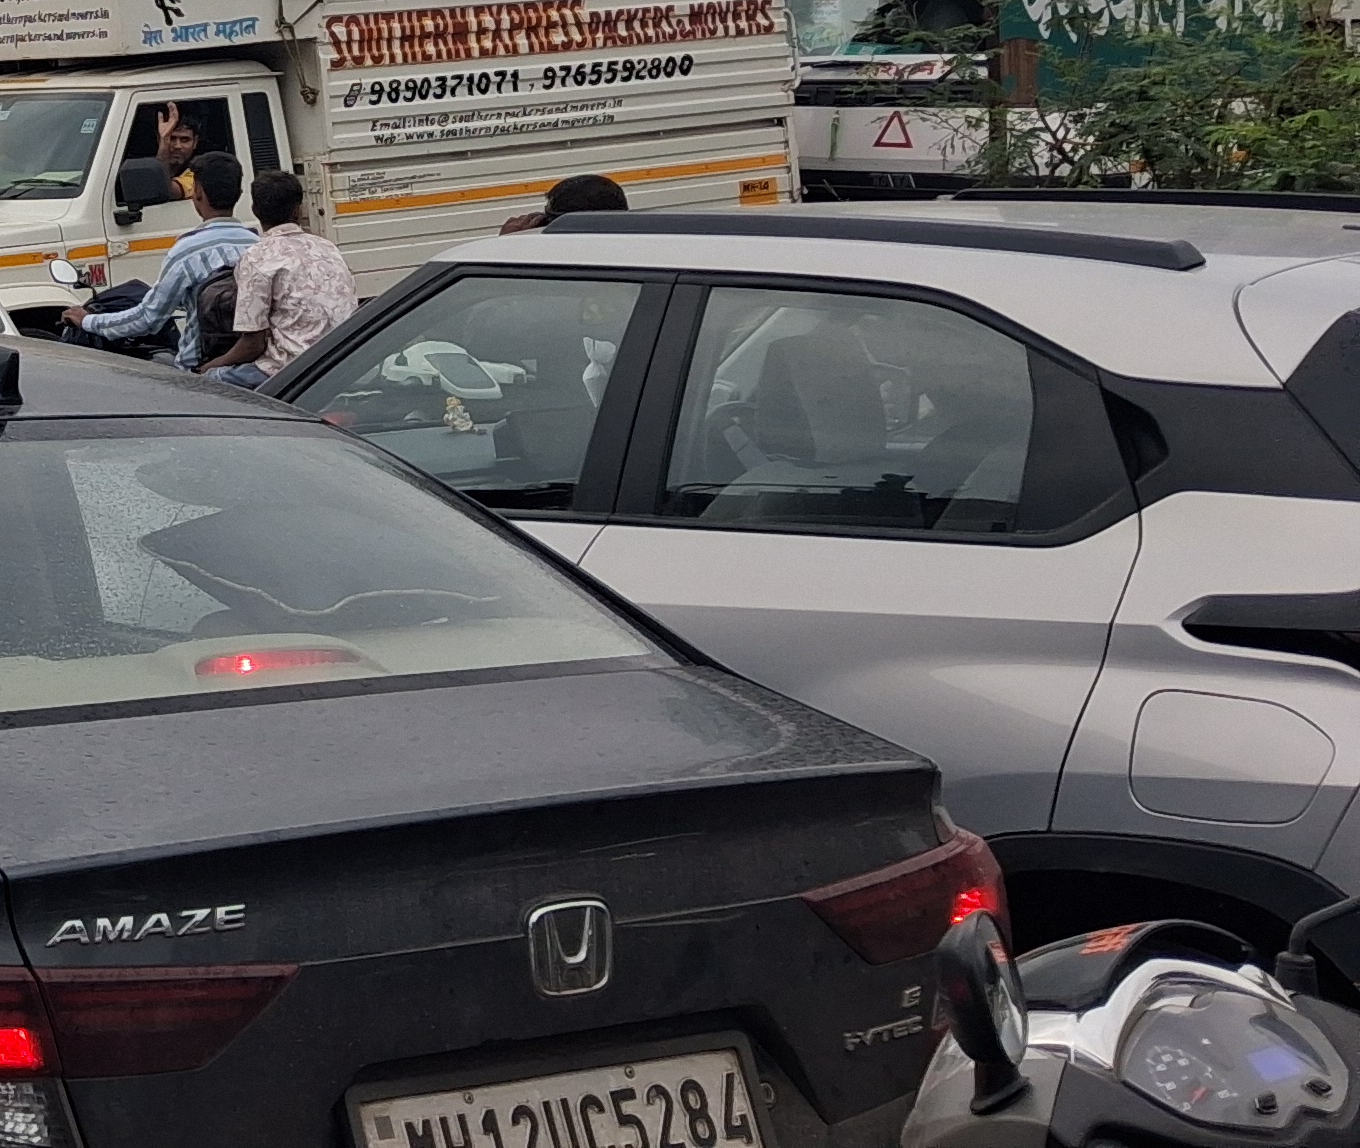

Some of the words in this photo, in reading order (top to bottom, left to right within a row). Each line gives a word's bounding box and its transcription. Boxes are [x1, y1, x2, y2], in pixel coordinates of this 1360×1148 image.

[142, 23, 164, 47] मेरा
[171, 22, 211, 43] भारत
[212, 17, 260, 43] महान
[326, 7, 475, 69] SOUTHERN
[475, 0, 588, 56] EXPRESS
[589, 5, 677, 47] PACKERS
[542, 53, 694, 91] 9765592800
[45, 904, 246, 948] AMAZE
